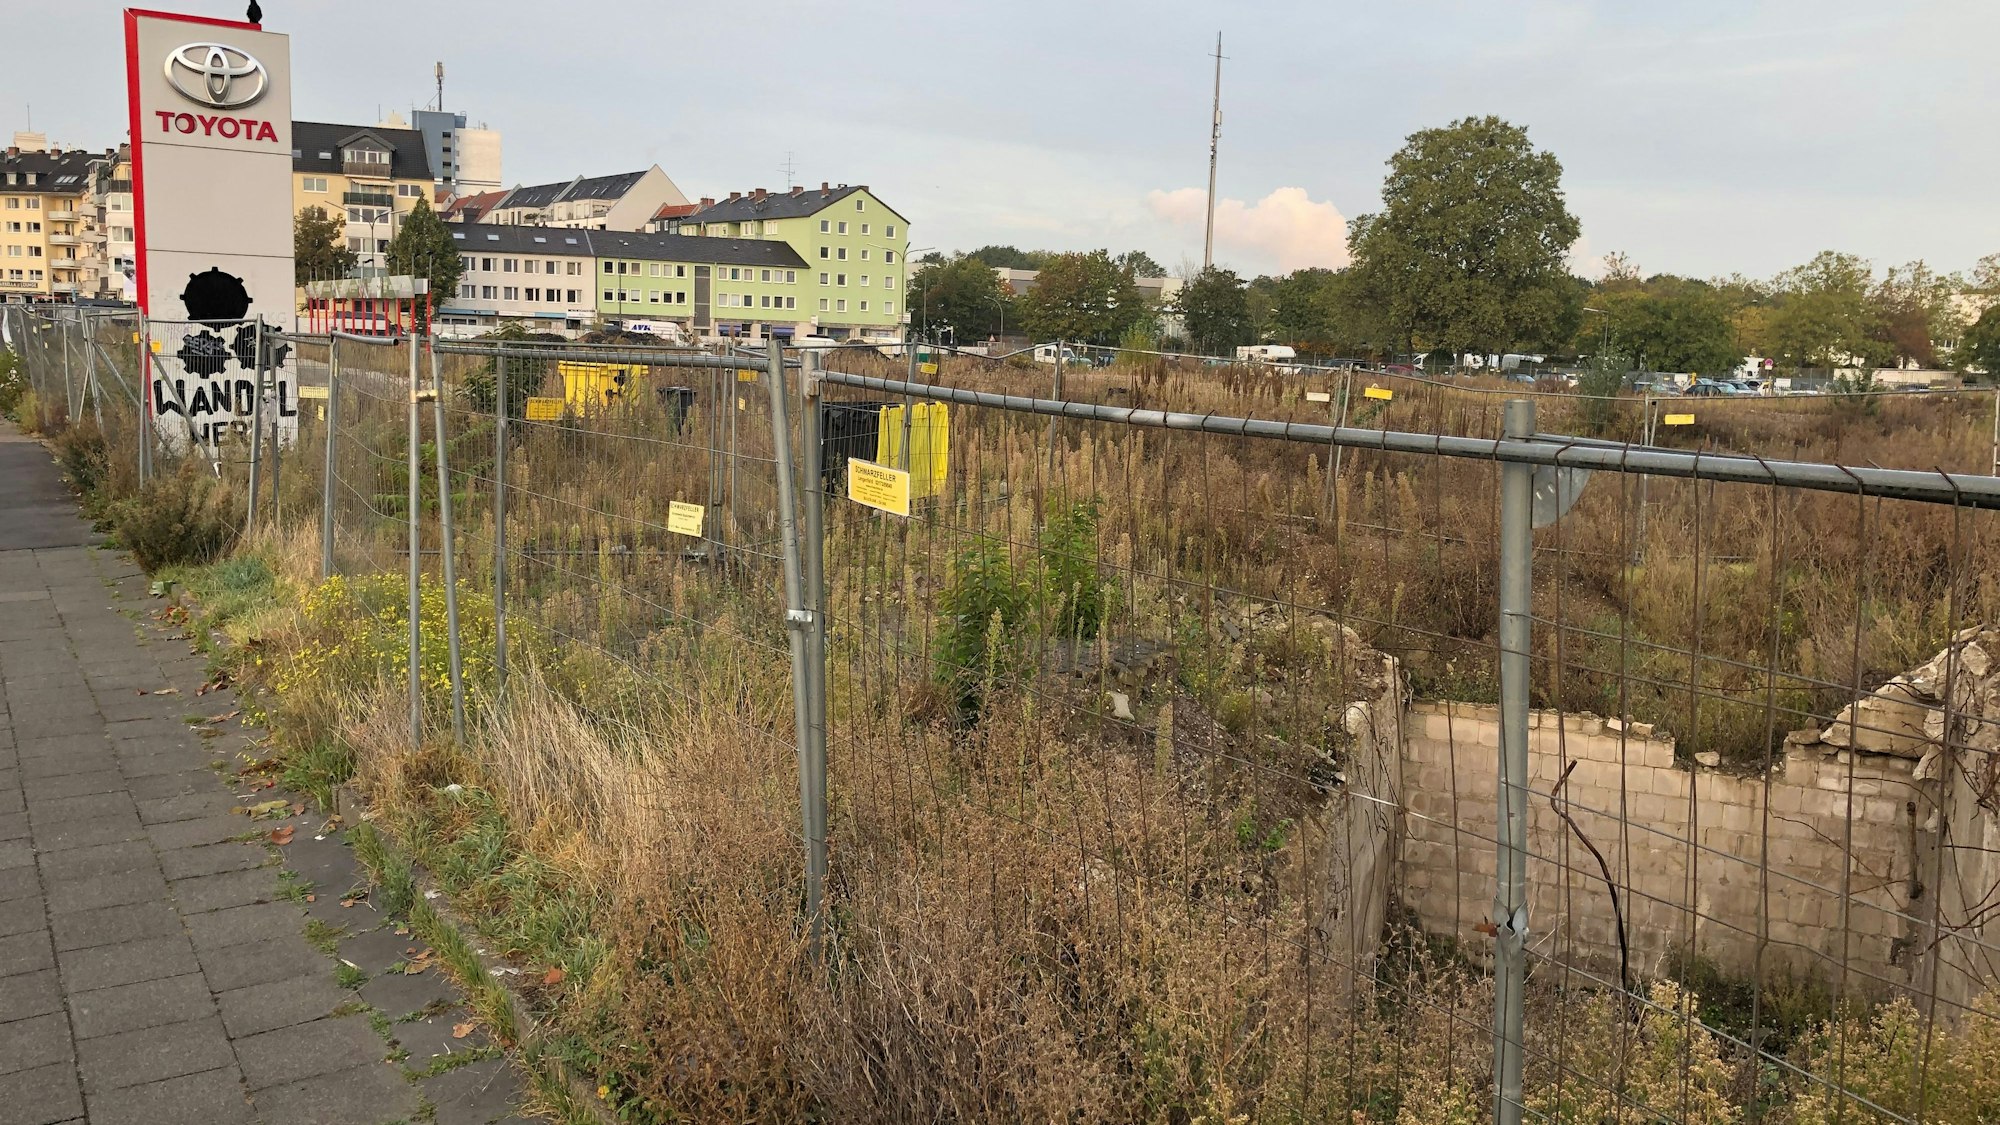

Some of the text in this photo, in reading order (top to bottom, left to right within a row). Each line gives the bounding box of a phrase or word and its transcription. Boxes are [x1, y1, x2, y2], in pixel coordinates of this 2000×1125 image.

[155, 110, 279, 143] TOYOTA
[153, 379, 297, 417] WANDL
[855, 465, 896, 483] SCHWARZFELLER
